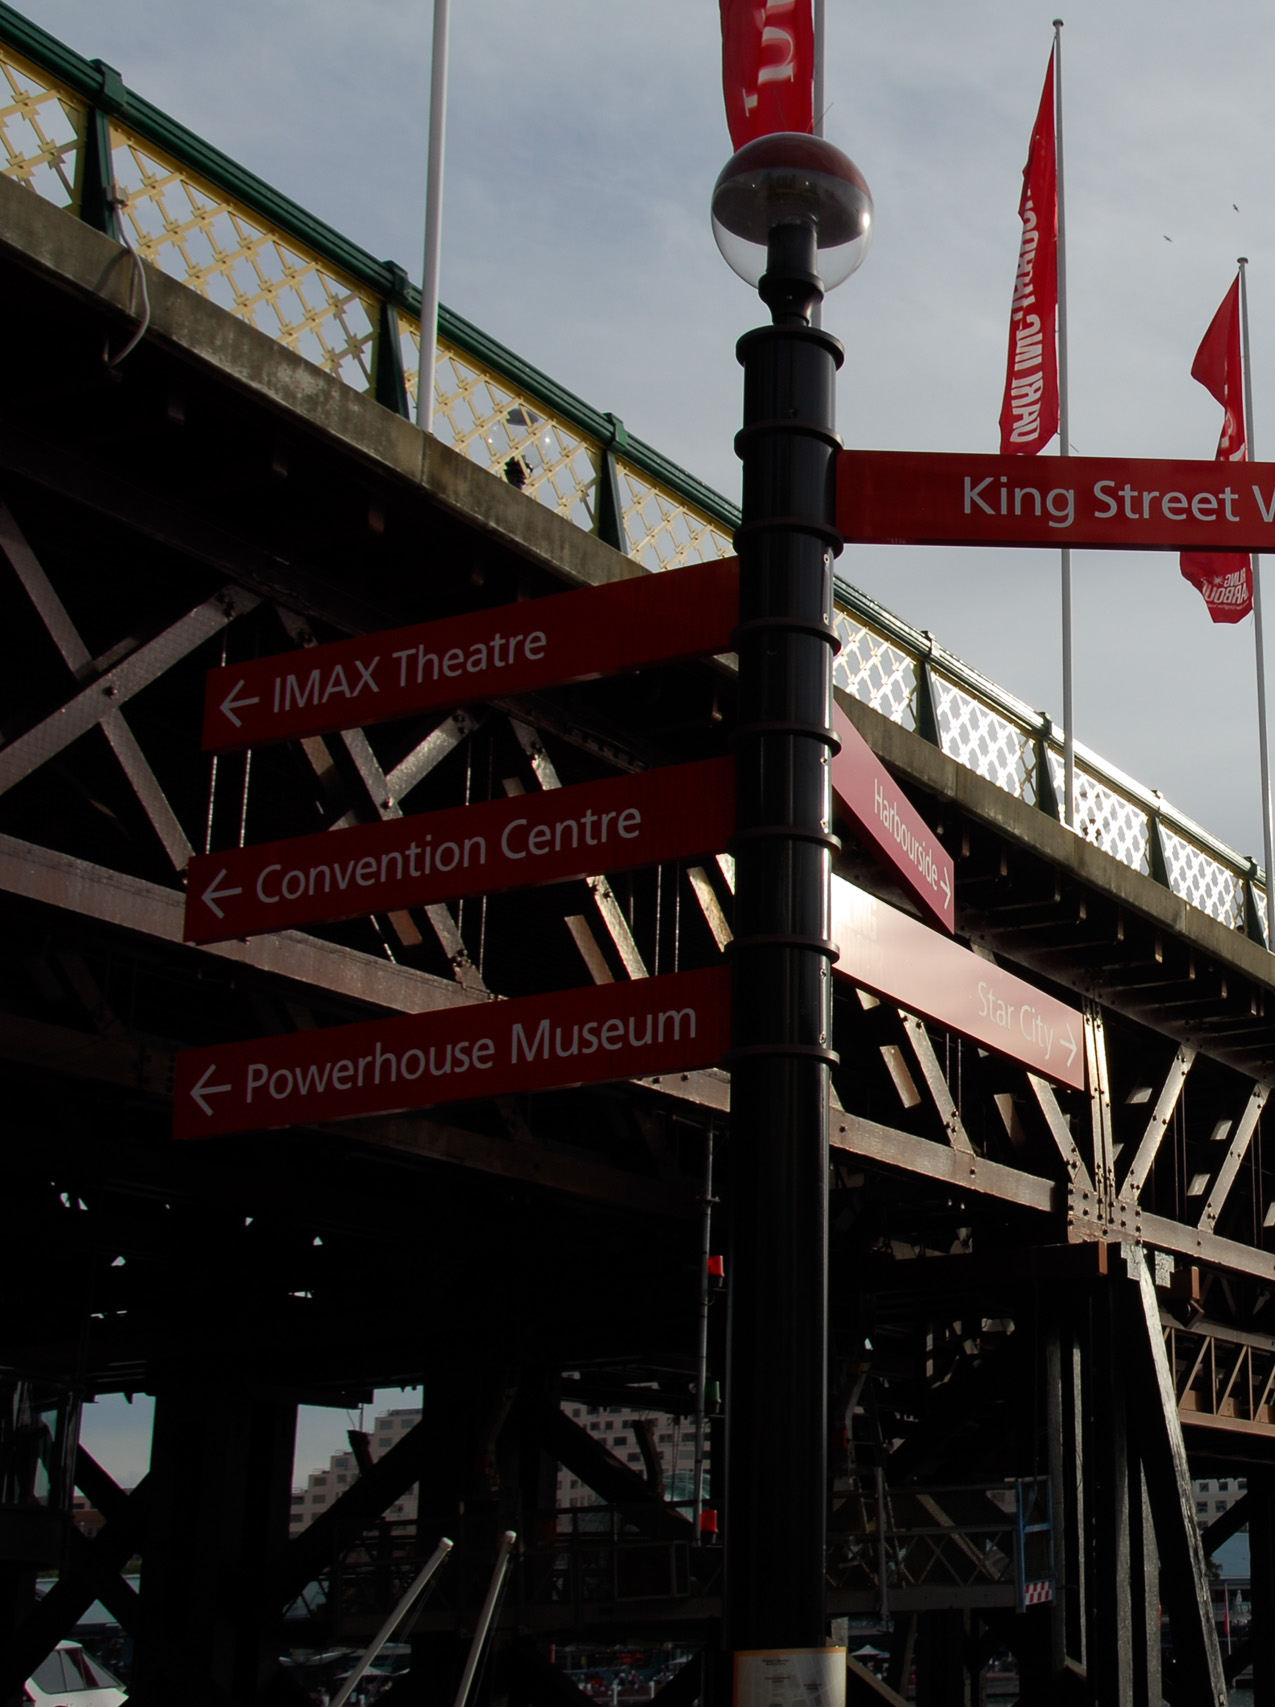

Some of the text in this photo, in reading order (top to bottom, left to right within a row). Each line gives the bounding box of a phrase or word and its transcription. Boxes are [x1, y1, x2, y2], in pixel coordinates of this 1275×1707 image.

[963, 477, 1076, 528] King
[1093, 480, 1240, 523] Street
[273, 630, 547, 713] IMAX Theatre
[255, 807, 642, 904] Convention Centre
[874, 778, 939, 892] Harbourside
[245, 1006, 698, 1103] Powerhouse Museum
[977, 980, 1054, 1060] Star City
